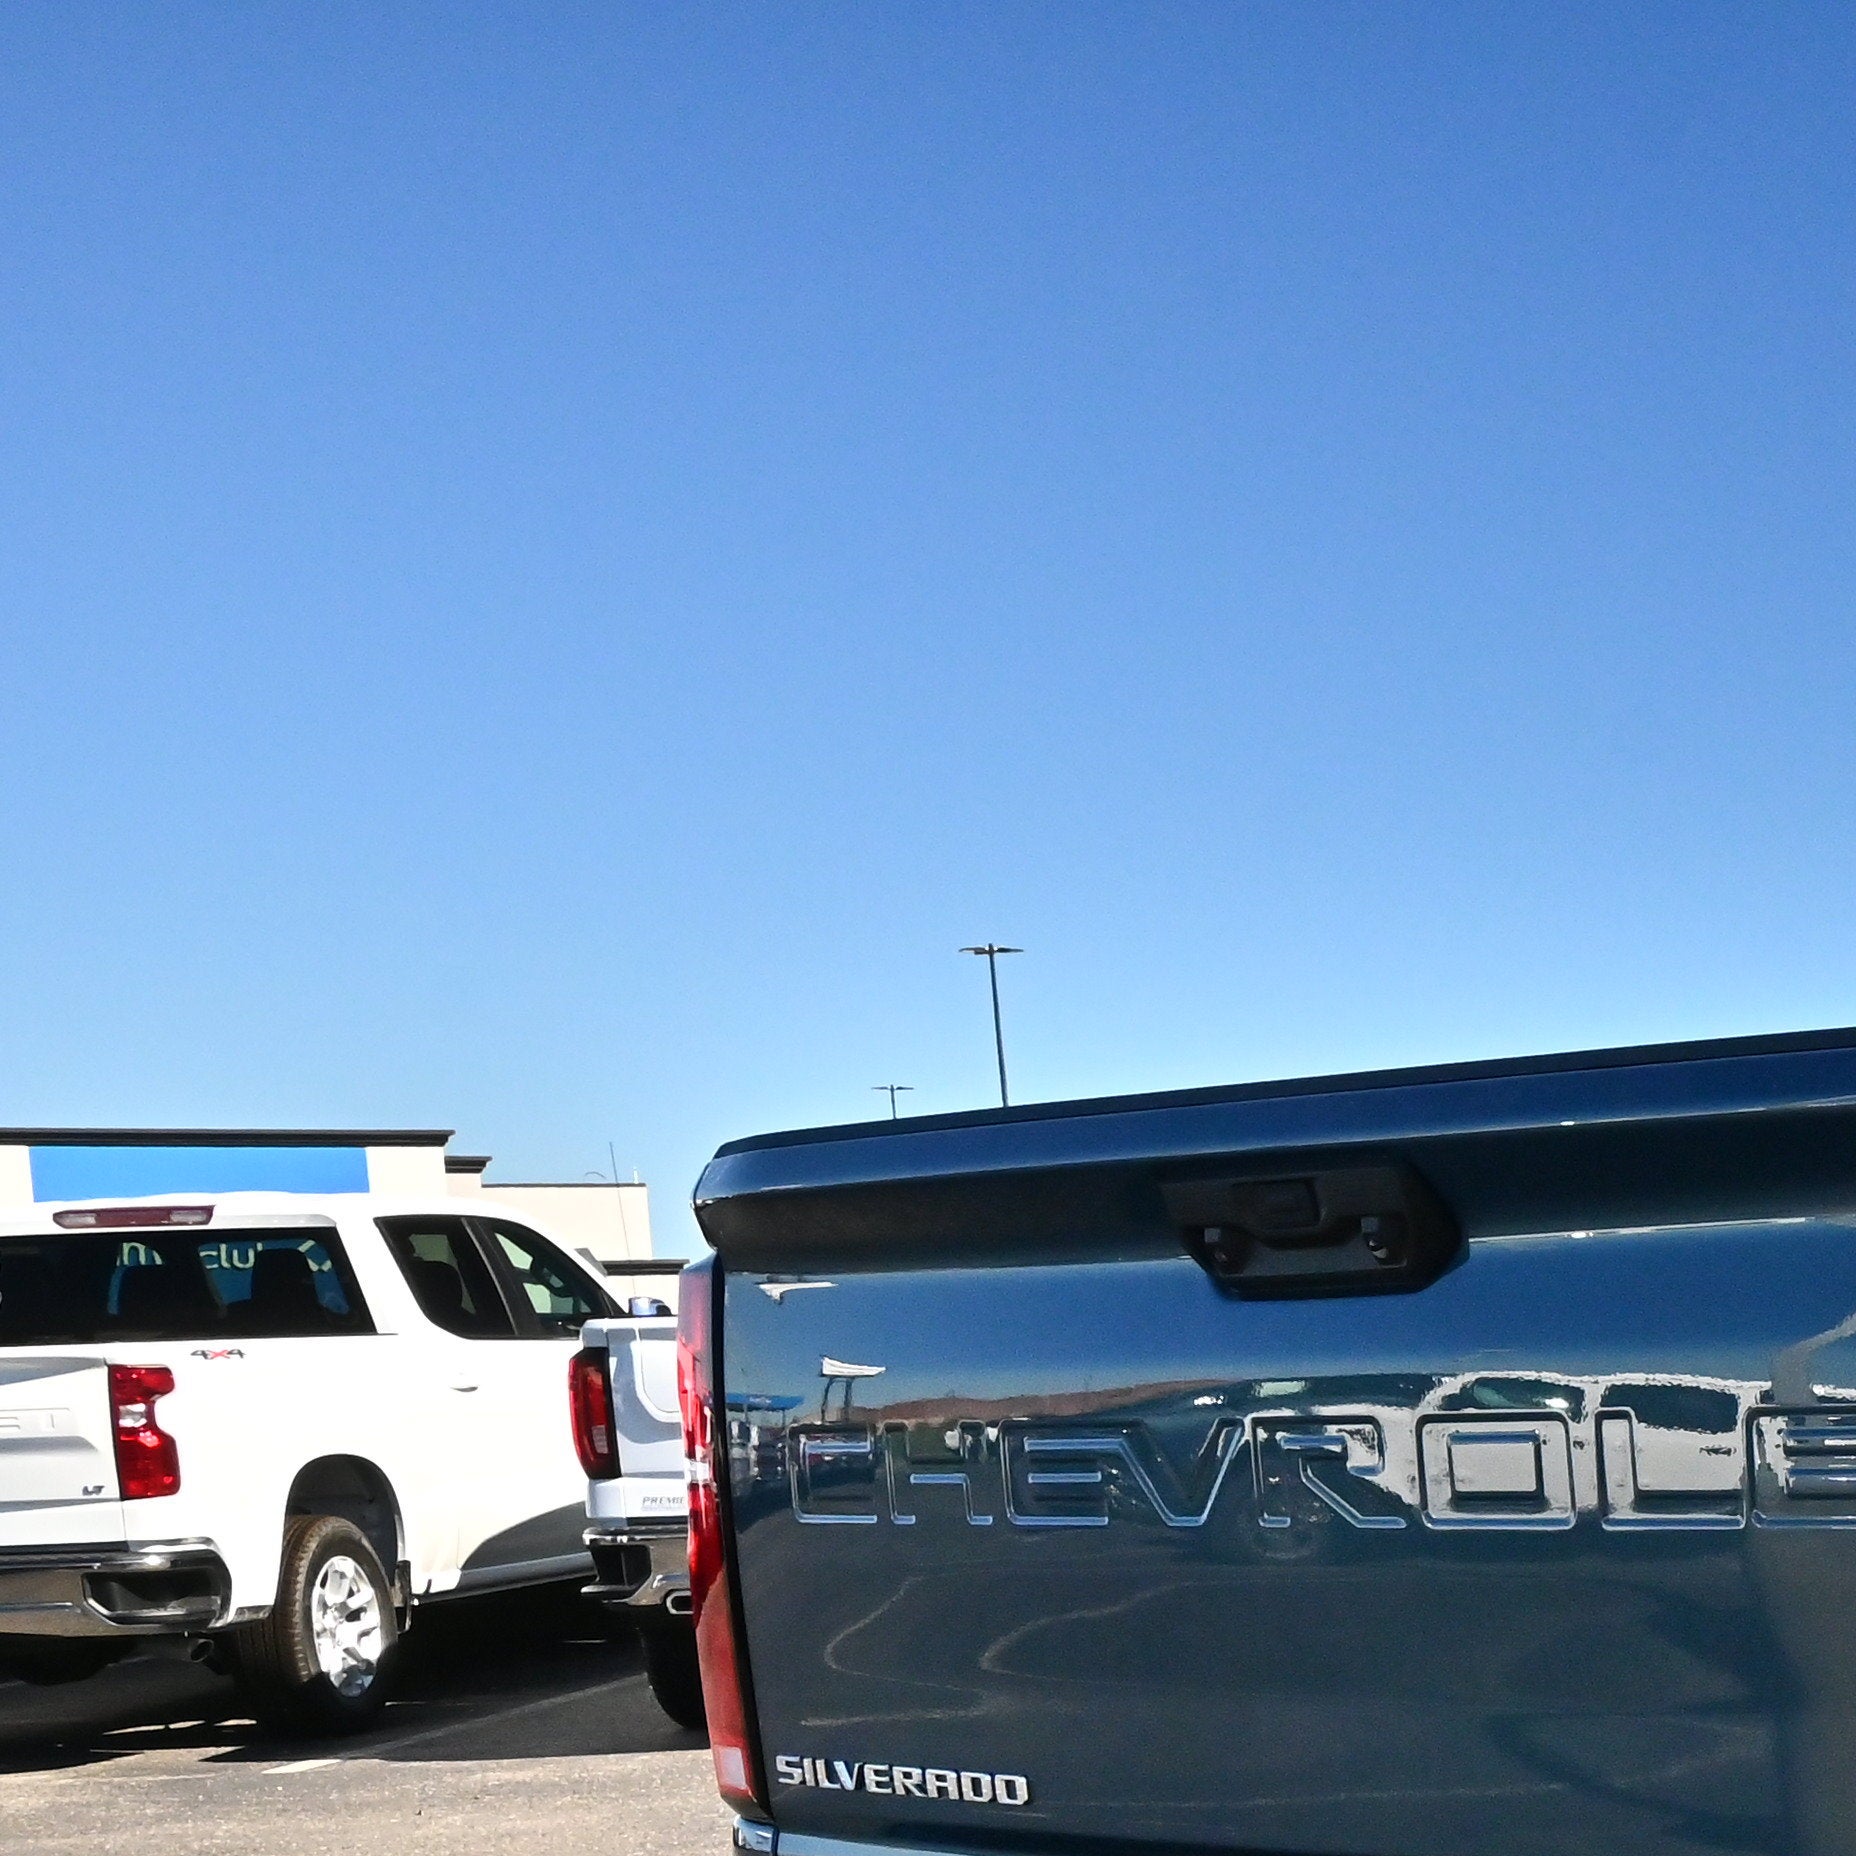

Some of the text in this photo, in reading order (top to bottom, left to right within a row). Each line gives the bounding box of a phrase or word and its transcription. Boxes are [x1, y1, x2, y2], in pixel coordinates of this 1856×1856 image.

[199, 1242, 263, 1269] clu
[82, 1485, 106, 1496] LT
[642, 1496, 685, 1504] PREMIE
[775, 1755, 1029, 1806] SILVERADO
